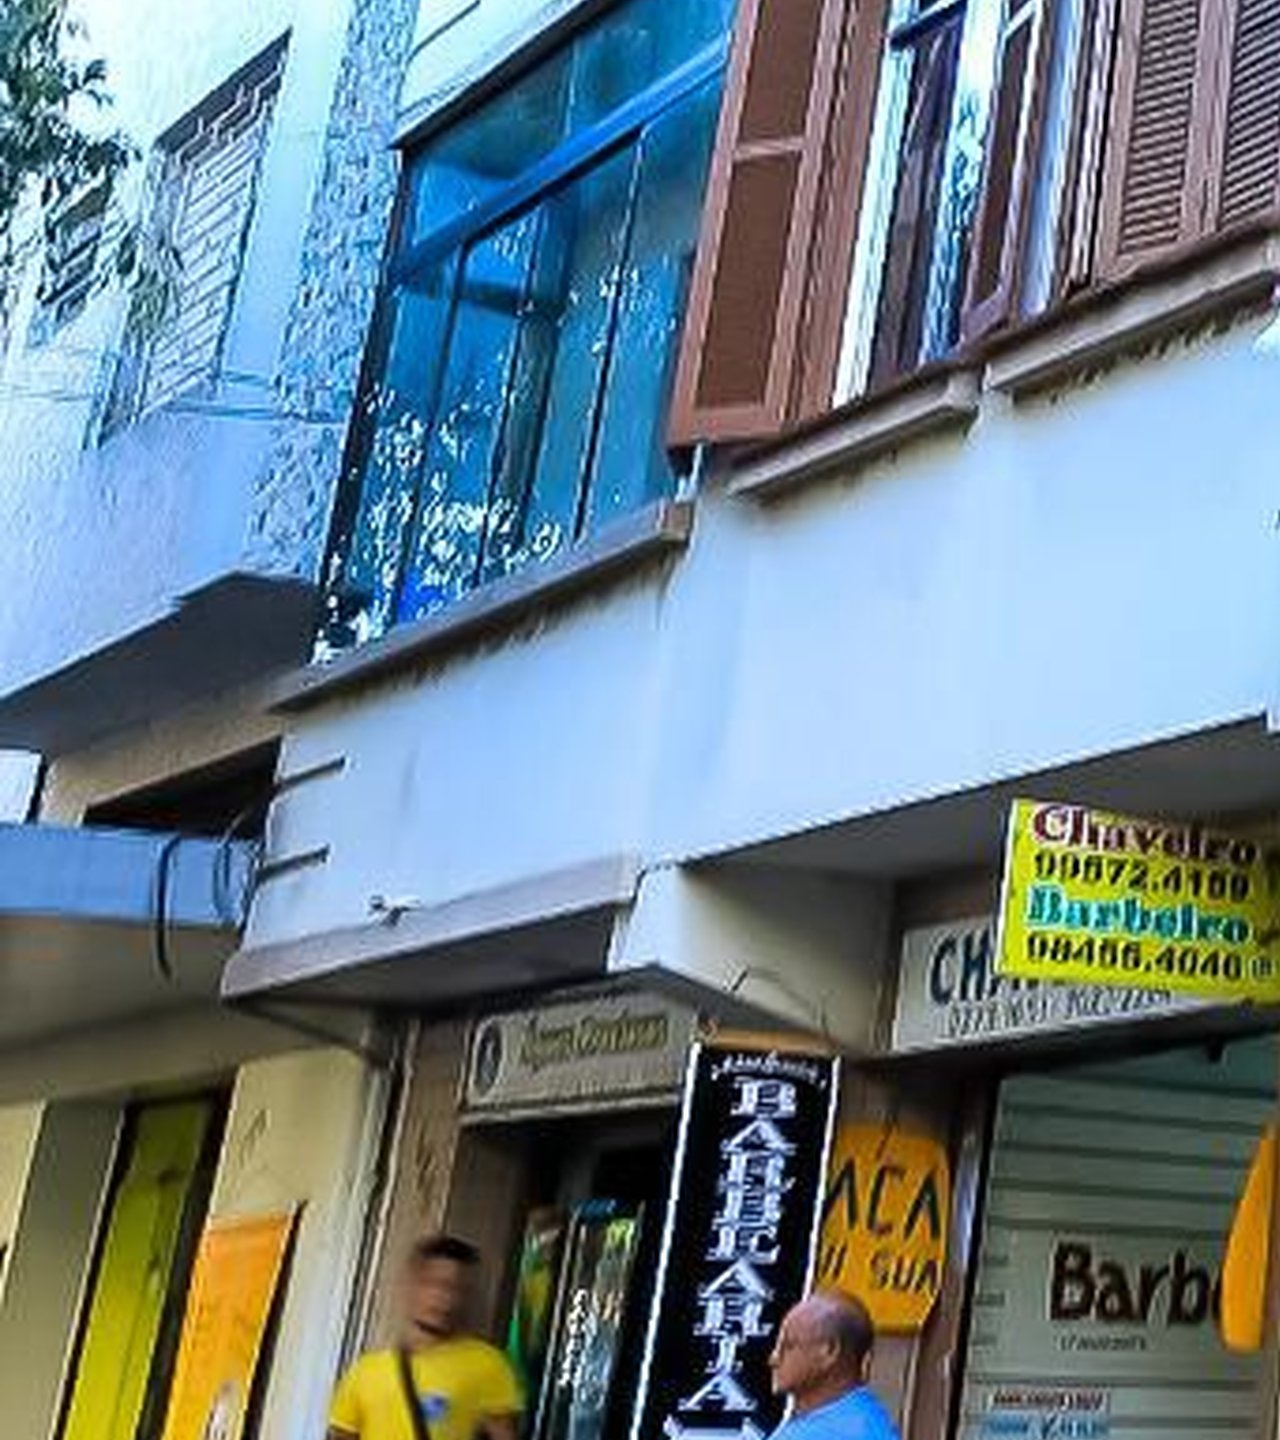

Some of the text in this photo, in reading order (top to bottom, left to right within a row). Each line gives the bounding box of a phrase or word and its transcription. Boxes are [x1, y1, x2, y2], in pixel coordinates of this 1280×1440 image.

[1026, 882, 1254, 944] Barbeiro
[678, 1078, 797, 1412] BARBEARIA
[1049, 1240, 1223, 1324] Barb
